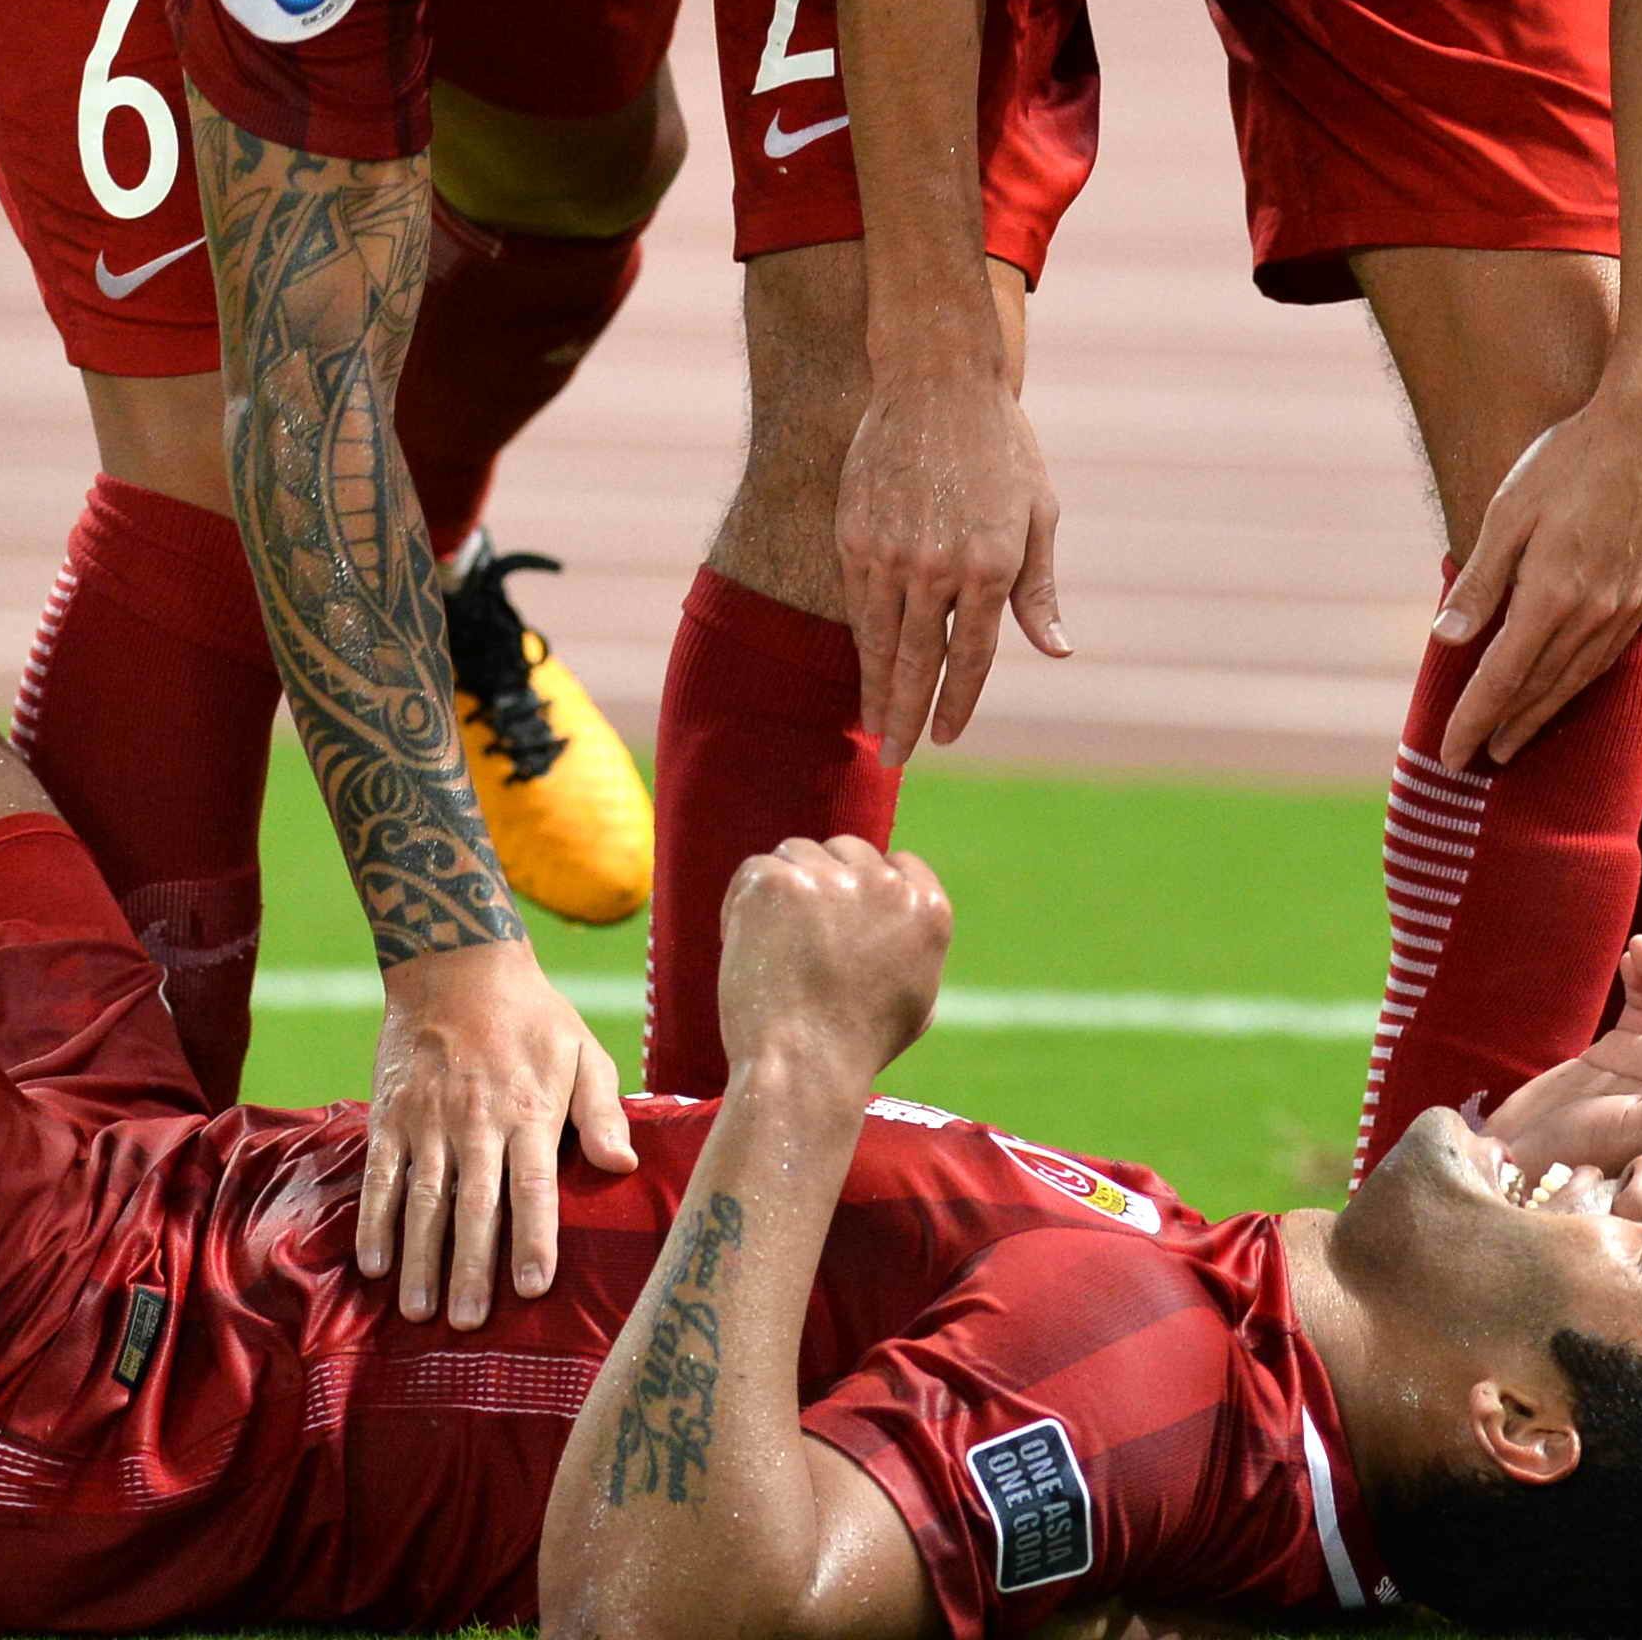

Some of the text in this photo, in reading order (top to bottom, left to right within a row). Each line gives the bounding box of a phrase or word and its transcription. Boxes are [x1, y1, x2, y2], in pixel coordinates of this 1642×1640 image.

[988, 1450, 1039, 1580] ONE GOAL
[1019, 1438, 1074, 1562] ONE ASIA
